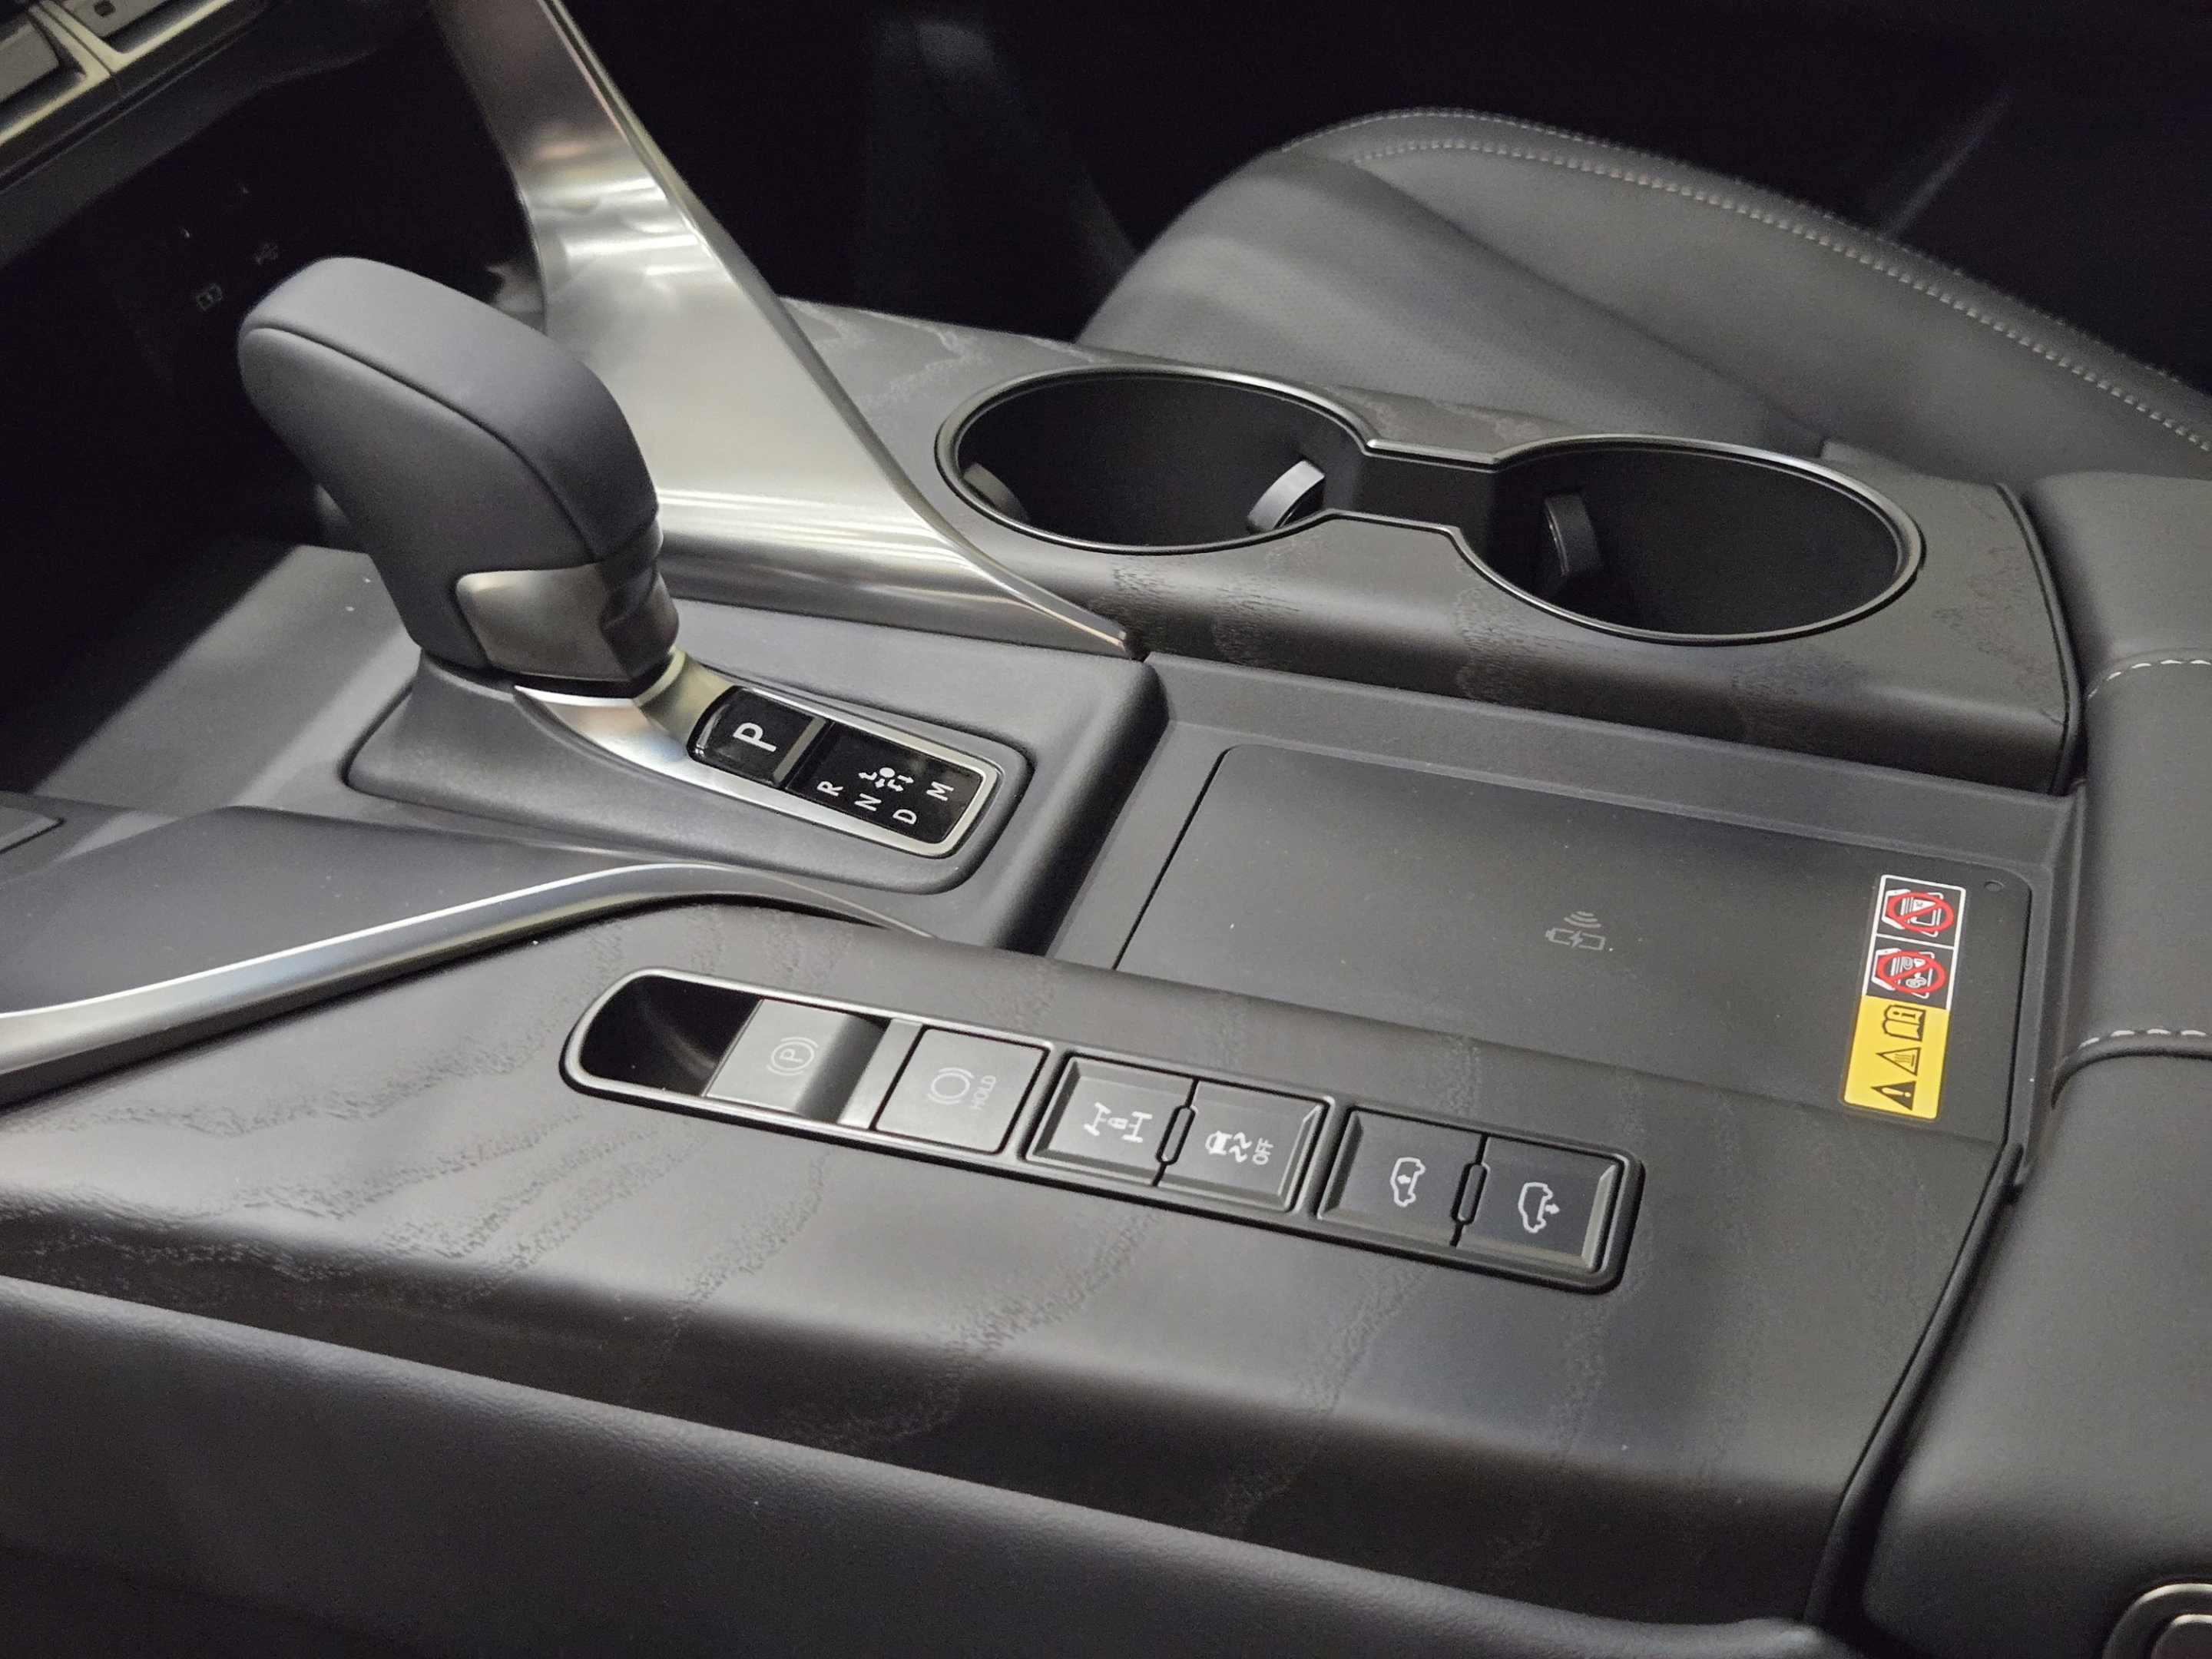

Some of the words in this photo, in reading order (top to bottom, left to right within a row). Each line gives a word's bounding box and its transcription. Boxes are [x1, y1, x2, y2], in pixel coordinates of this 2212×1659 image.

[732, 722, 777, 752] P
[816, 780, 844, 797] R
[926, 781, 955, 802] M
[854, 793, 882, 812] N
[892, 809, 917, 825] D
[780, 1048, 804, 1063] P
[969, 1075, 997, 1111] HOLD
[1252, 1137, 1273, 1165] OFF
